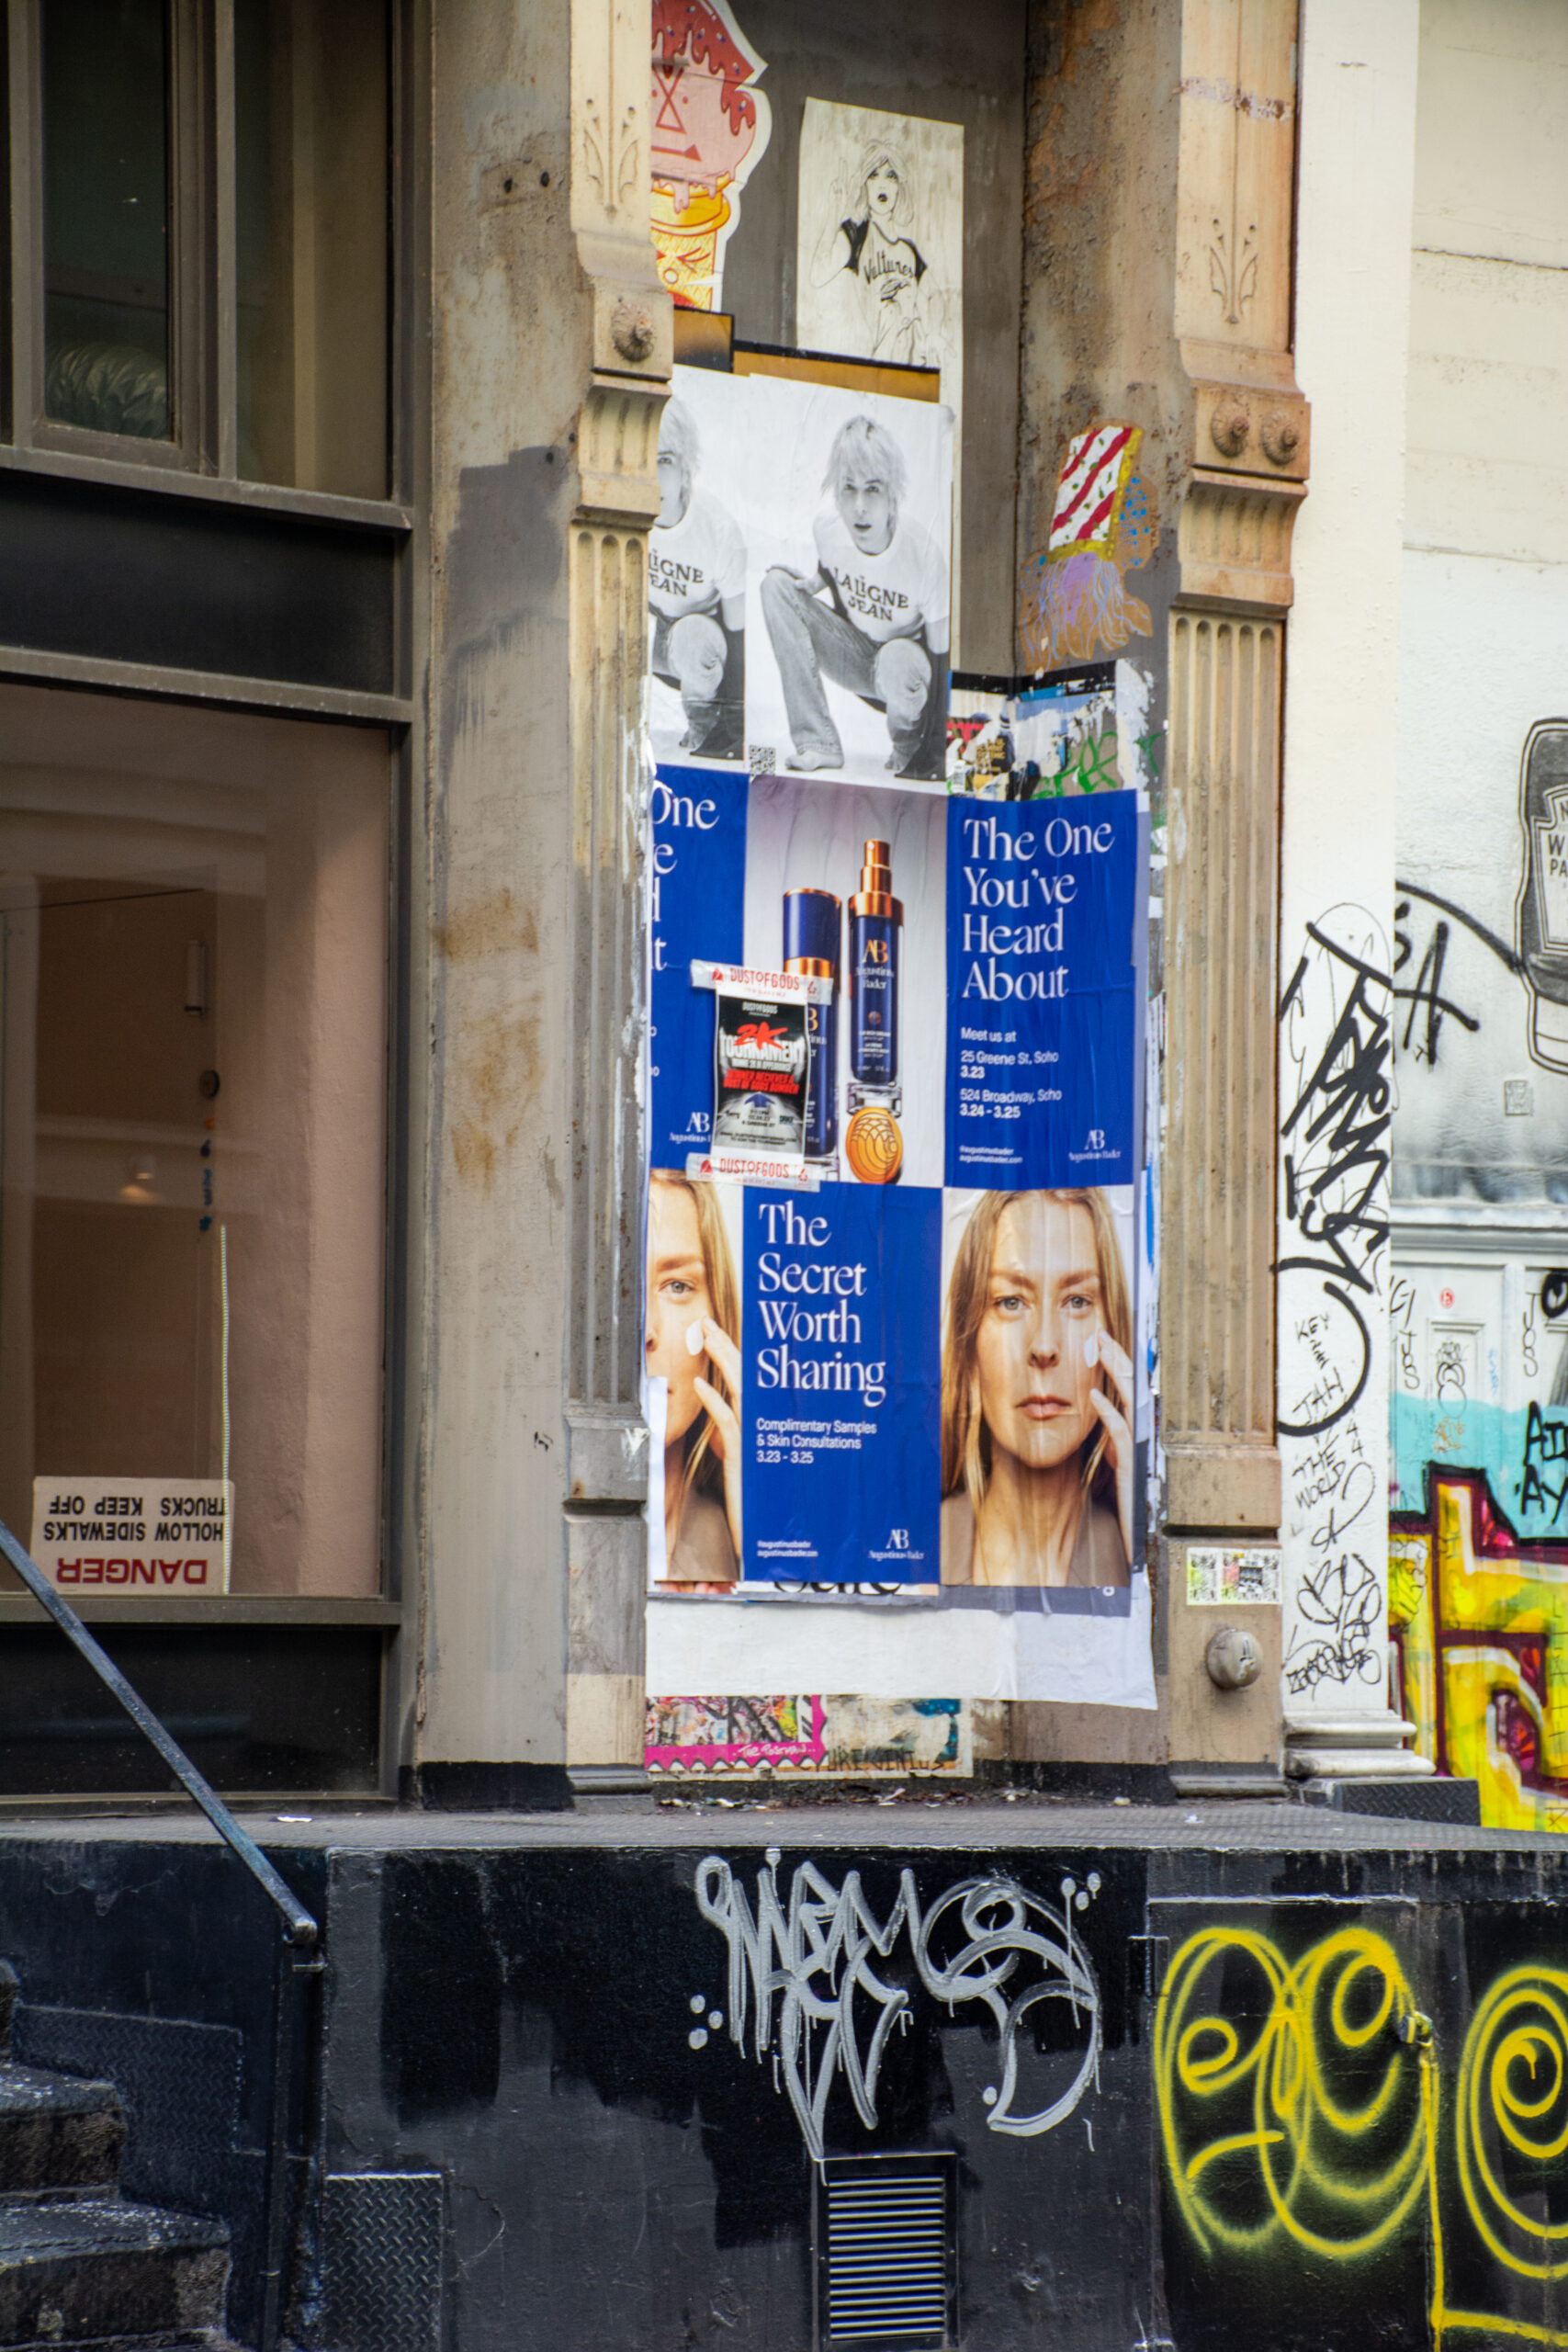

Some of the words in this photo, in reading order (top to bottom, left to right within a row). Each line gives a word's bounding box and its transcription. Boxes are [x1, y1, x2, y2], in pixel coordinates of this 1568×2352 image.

[848, 595, 893, 622] JEAN
[964, 816, 1038, 861] The
[1044, 818, 1115, 857] One
[963, 866, 1078, 908] You've
[963, 907, 1064, 955] Heard
[862, 939, 889, 964] AB
[729, 967, 800, 991] DUSTOFGODS
[962, 957, 1069, 1001] About
[733, 1022, 788, 1051] 2K
[961, 1027, 987, 1041] Meet
[989, 1031, 1002, 1042] us
[1004, 1031, 1017, 1043] at
[961, 1050, 975, 1063] 25
[976, 1051, 1016, 1065] Greene
[1033, 1051, 1059, 1064] Soho
[961, 1065, 985, 1079] 3.23
[960, 1088, 980, 1101] 524
[982, 1090, 1035, 1104] Broadway,
[1037, 1089, 1062, 1102] Soho
[960, 1103, 985, 1116] 3.24
[993, 1105, 1021, 1118] 3.25
[686, 1112, 710, 1132] AB
[1084, 1129, 1105, 1150] AB
[719, 1158, 789, 1179] DUSTOFGODS
[759, 1200, 831, 1247] The
[758, 1252, 867, 1296] Secret
[759, 1299, 862, 1343] Worth
[757, 1344, 886, 1407] Sharing
[756, 1418, 831, 1435] Complimentary
[833, 1419, 877, 1435] Samples
[757, 1434, 764, 1446] &
[767, 1434, 790, 1447] Skin
[792, 1435, 862, 1449] Consultations
[757, 1451, 781, 1463] 3.23
[790, 1452, 814, 1464] 3.25
[50, 1496, 85, 1515] OFF
[95, 1497, 143, 1516] KEEP
[162, 1498, 225, 1516] TRUCKS
[44, 1521, 146, 1542] SIDEWALKS
[155, 1522, 223, 1542] HOLLOW
[886, 1529, 909, 1549] AB
[56, 1558, 208, 1584] DANGER
